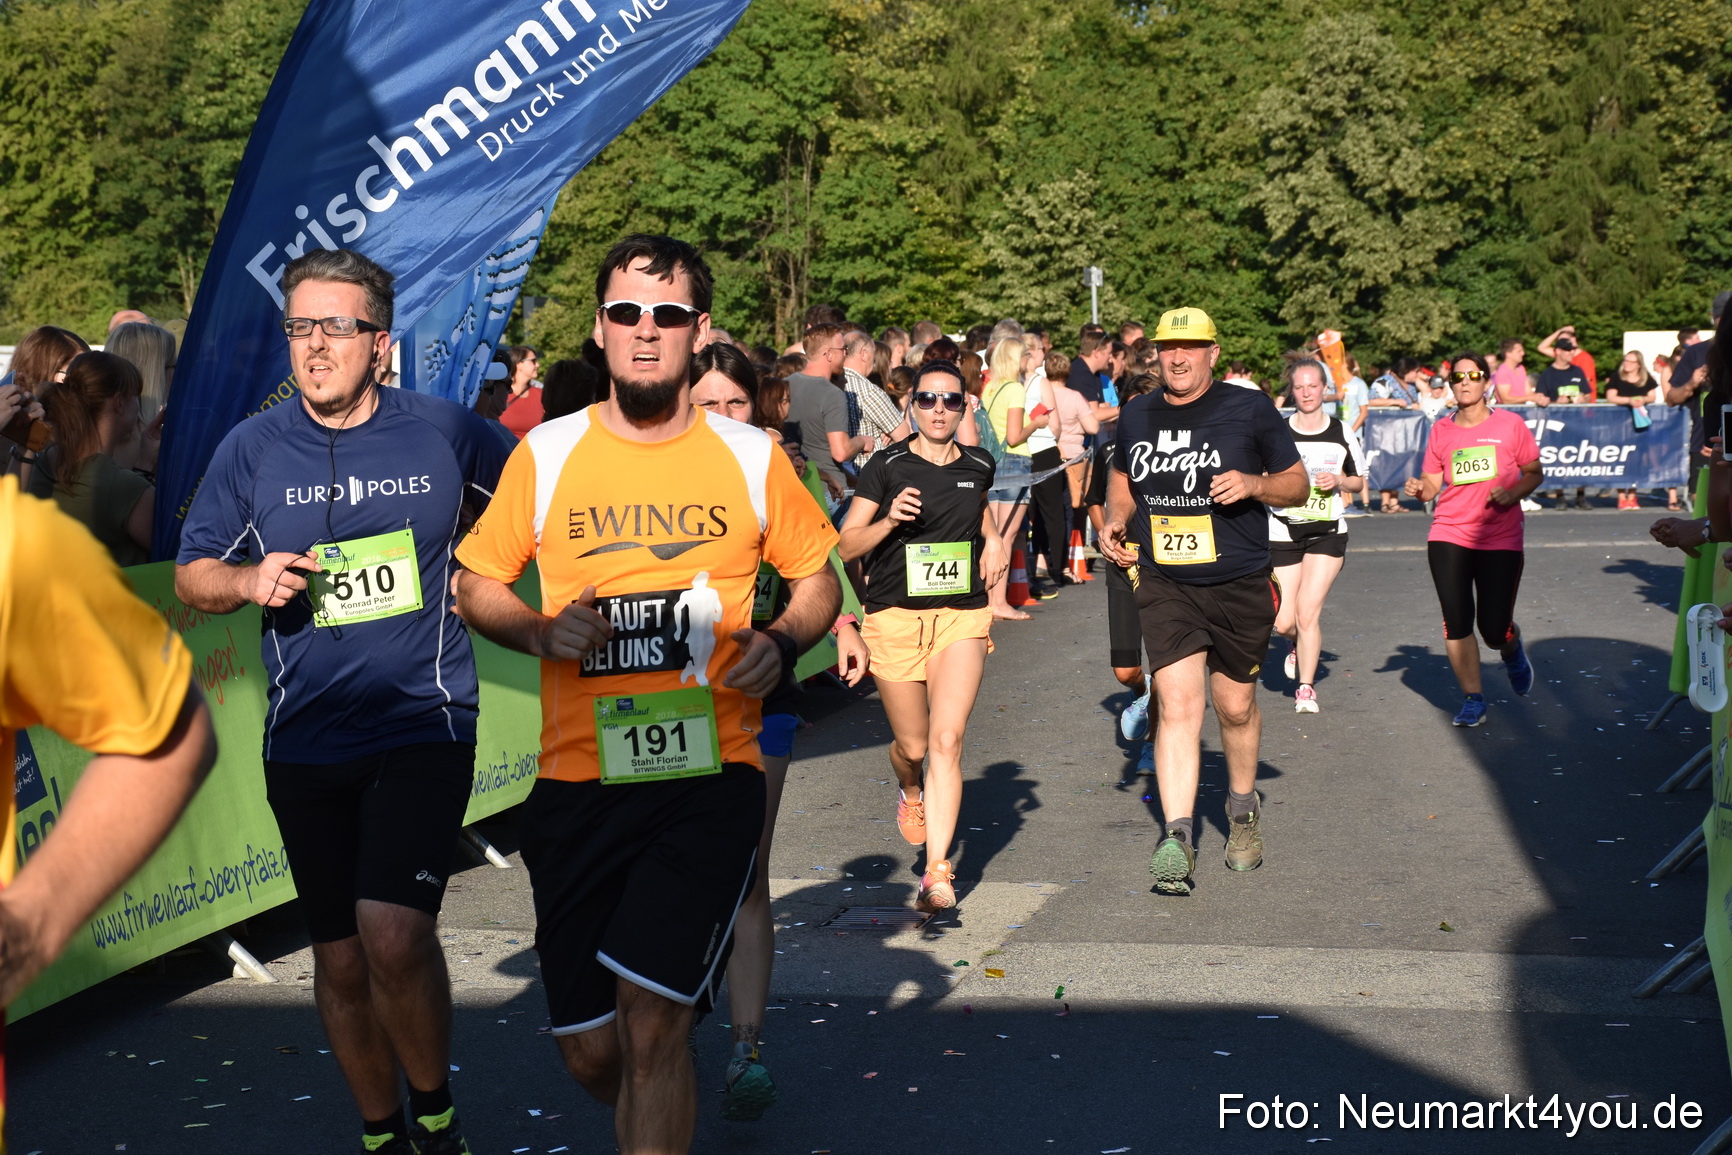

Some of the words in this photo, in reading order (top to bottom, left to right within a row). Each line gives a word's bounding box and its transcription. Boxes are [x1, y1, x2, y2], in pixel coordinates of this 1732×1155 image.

[476, 82, 565, 162] Druck
[562, 24, 621, 86] und
[1129, 441, 1221, 493] Burgis
[1455, 458, 1490, 475] 2063
[1539, 440, 1637, 464] scher
[286, 484, 344, 505] EURO
[367, 475, 431, 498] POLES
[569, 508, 585, 540] BIT
[588, 504, 728, 538] WINGS
[1163, 533, 1198, 550] 273
[333, 564, 395, 601] 510
[922, 561, 959, 580] 744
[340, 599, 372, 610] Konrad
[374, 594, 396, 606] Peter
[597, 597, 666, 632] ÄUFT
[618, 636, 664, 669] UNS
[624, 721, 687, 757] 191
[631, 757, 654, 767] Stahl
[656, 755, 688, 765] Florian
[634, 766, 666, 774] BITWINGS
[667, 763, 687, 771] GmbH
